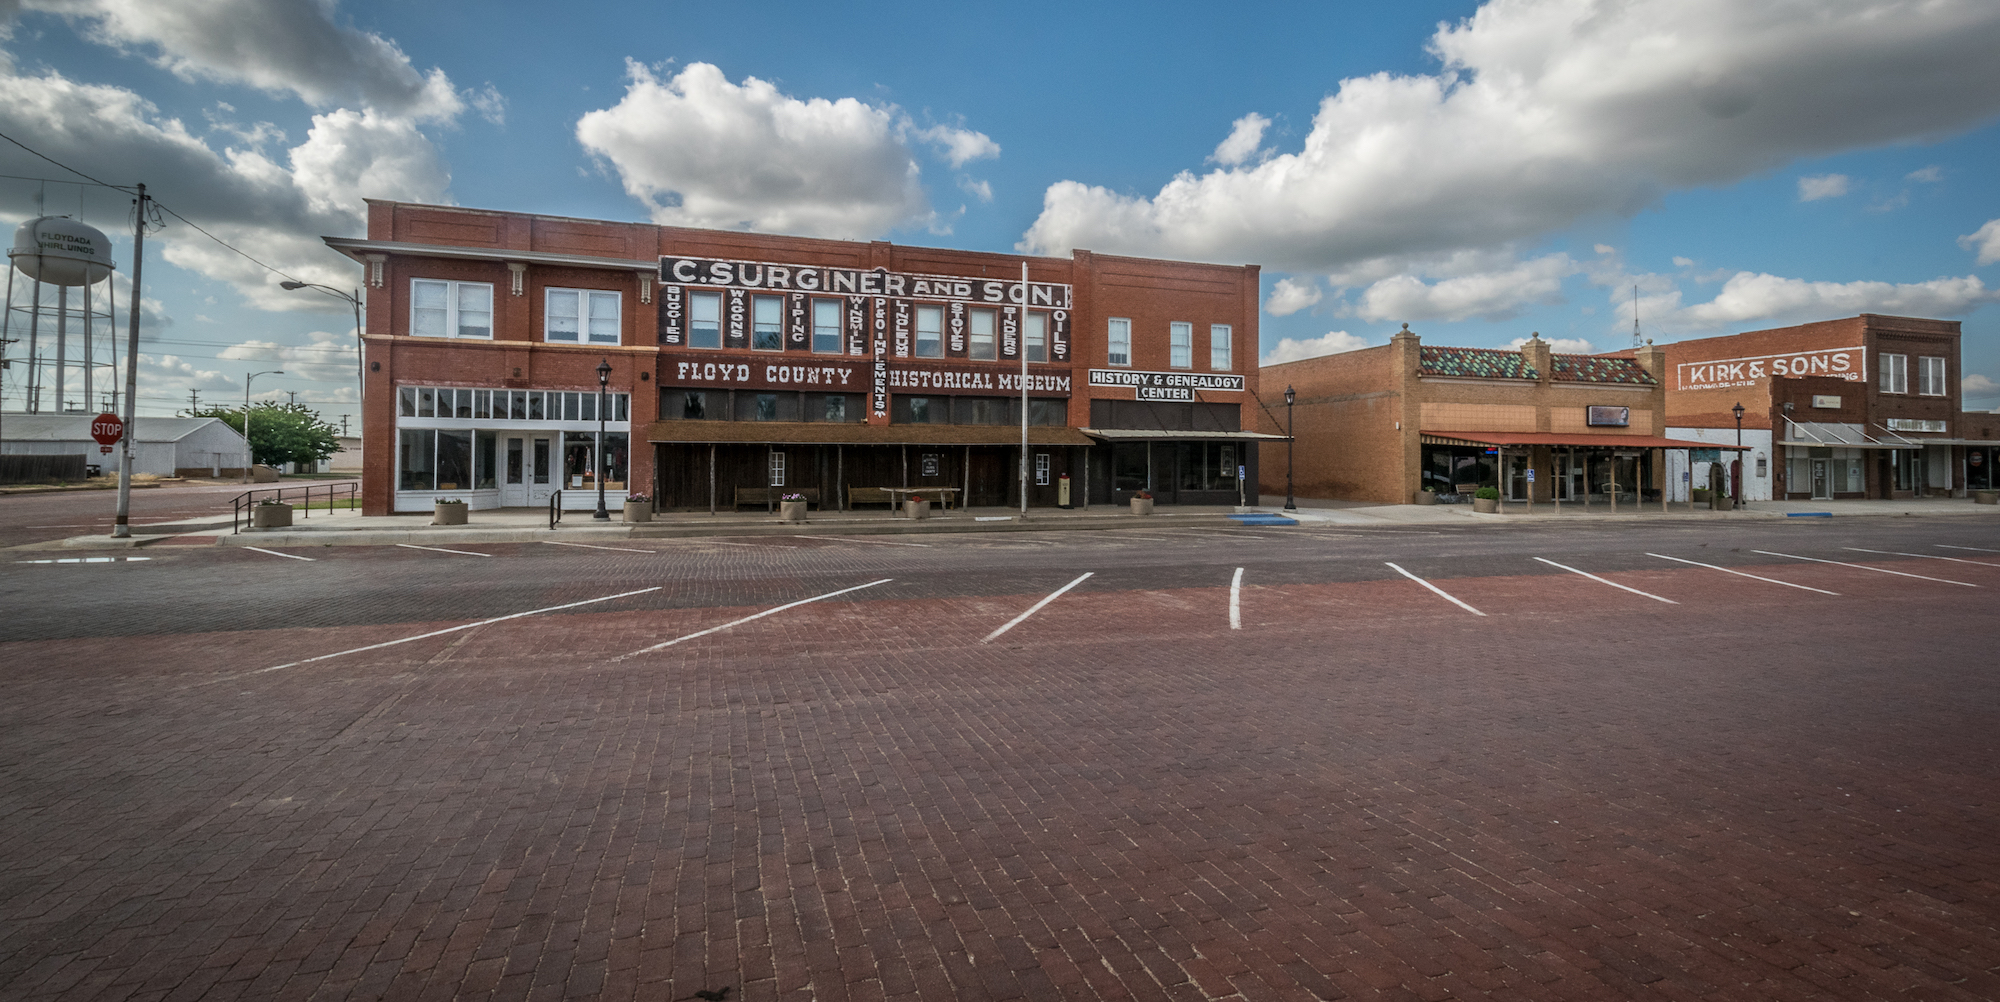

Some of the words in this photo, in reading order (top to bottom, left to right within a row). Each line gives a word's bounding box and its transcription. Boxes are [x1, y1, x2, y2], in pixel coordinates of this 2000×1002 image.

[41, 232, 91, 245] FLOYDADA
[913, 281, 972, 297] AND
[666, 285, 681, 344] BUGGIES
[730, 289, 745, 338] WAGONS
[791, 293, 805, 342] PIPING
[849, 296, 865, 356] WINDMILLS
[951, 303, 964, 352] STOVES
[1003, 307, 1017, 356] BINDERS
[677, 362, 750, 382] FLOYD
[766, 365, 852, 385] COUNTY
[873, 332, 887, 409] IMPLEMENTS
[889, 370, 993, 390] HISTORICAL
[998, 373, 1071, 392] MUSEUM
[1092, 371, 1150, 385] HISTORY
[1153, 375, 1162, 386] &
[1166, 374, 1241, 389] GENEALOGY
[1691, 362, 1745, 383] KIRK
[1748, 360, 1766, 379] &
[1771, 352, 1851, 376] SONS
[1141, 387, 1189, 399] CENTER
[93, 422, 122, 436] STOP
